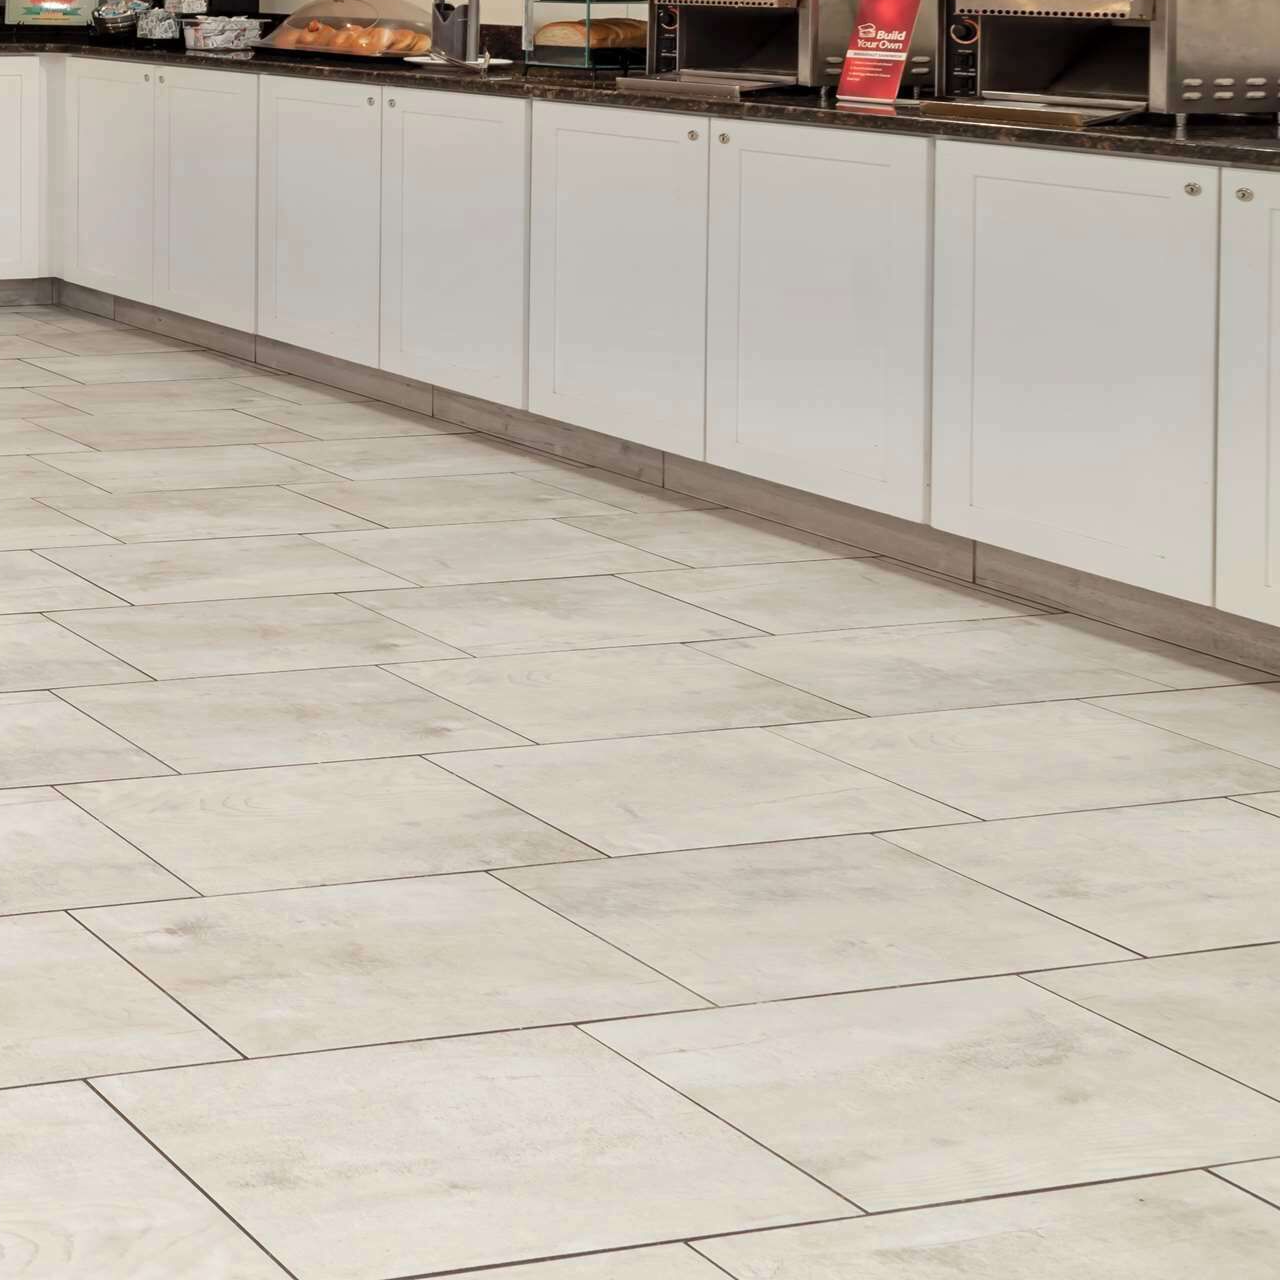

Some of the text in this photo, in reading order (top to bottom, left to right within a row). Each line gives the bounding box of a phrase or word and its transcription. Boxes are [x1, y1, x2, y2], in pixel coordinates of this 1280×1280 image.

[876, 30, 907, 41] Build
[857, 38, 903, 50] Your Own
